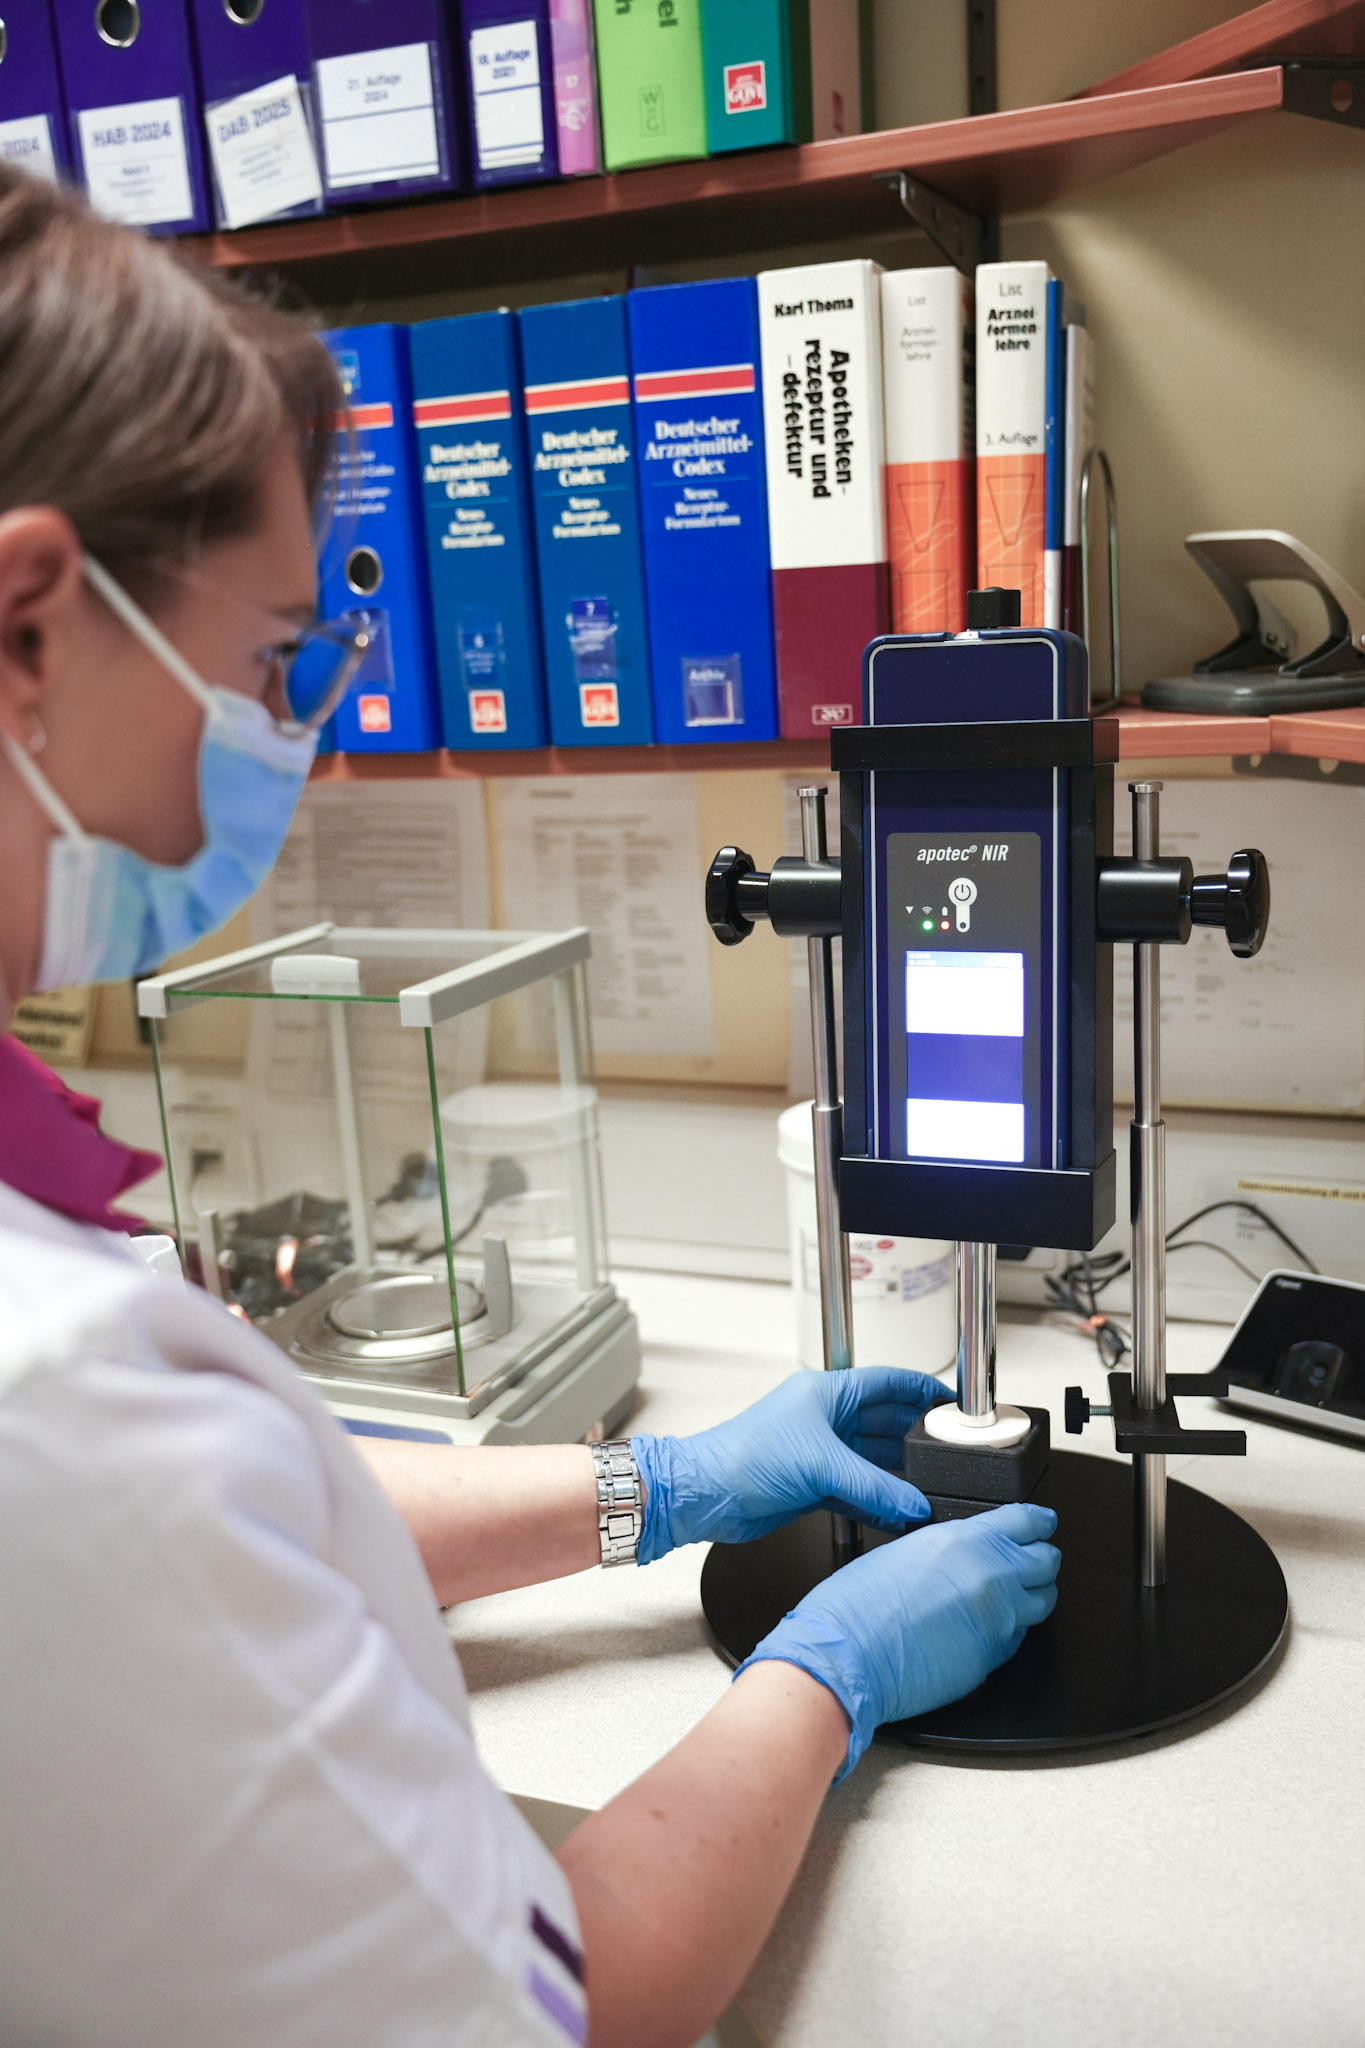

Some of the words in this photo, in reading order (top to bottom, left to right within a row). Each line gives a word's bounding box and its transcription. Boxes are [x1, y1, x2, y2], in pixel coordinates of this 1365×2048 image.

[131, 120, 171, 143] 2024
[999, 283, 1023, 297] List
[775, 301, 804, 318] Karl
[808, 298, 854, 314] Thoma
[995, 339, 1030, 352] lehre
[805, 339, 827, 445] rezeptur
[542, 427, 618, 451] Deutscher
[654, 416, 740, 440] Deutscher
[999, 431, 1037, 447] Auflage
[430, 440, 501, 464] Deutscher
[534, 443, 630, 471] Arzneimittel-
[645, 433, 754, 460] Arzneimittel-
[558, 467, 606, 487] Codex
[672, 456, 725, 478] Codex
[811, 453, 832, 499] und
[445, 479, 491, 499] Codex
[683, 487, 719, 501] Neues
[981, 844, 1009, 861] NIR
